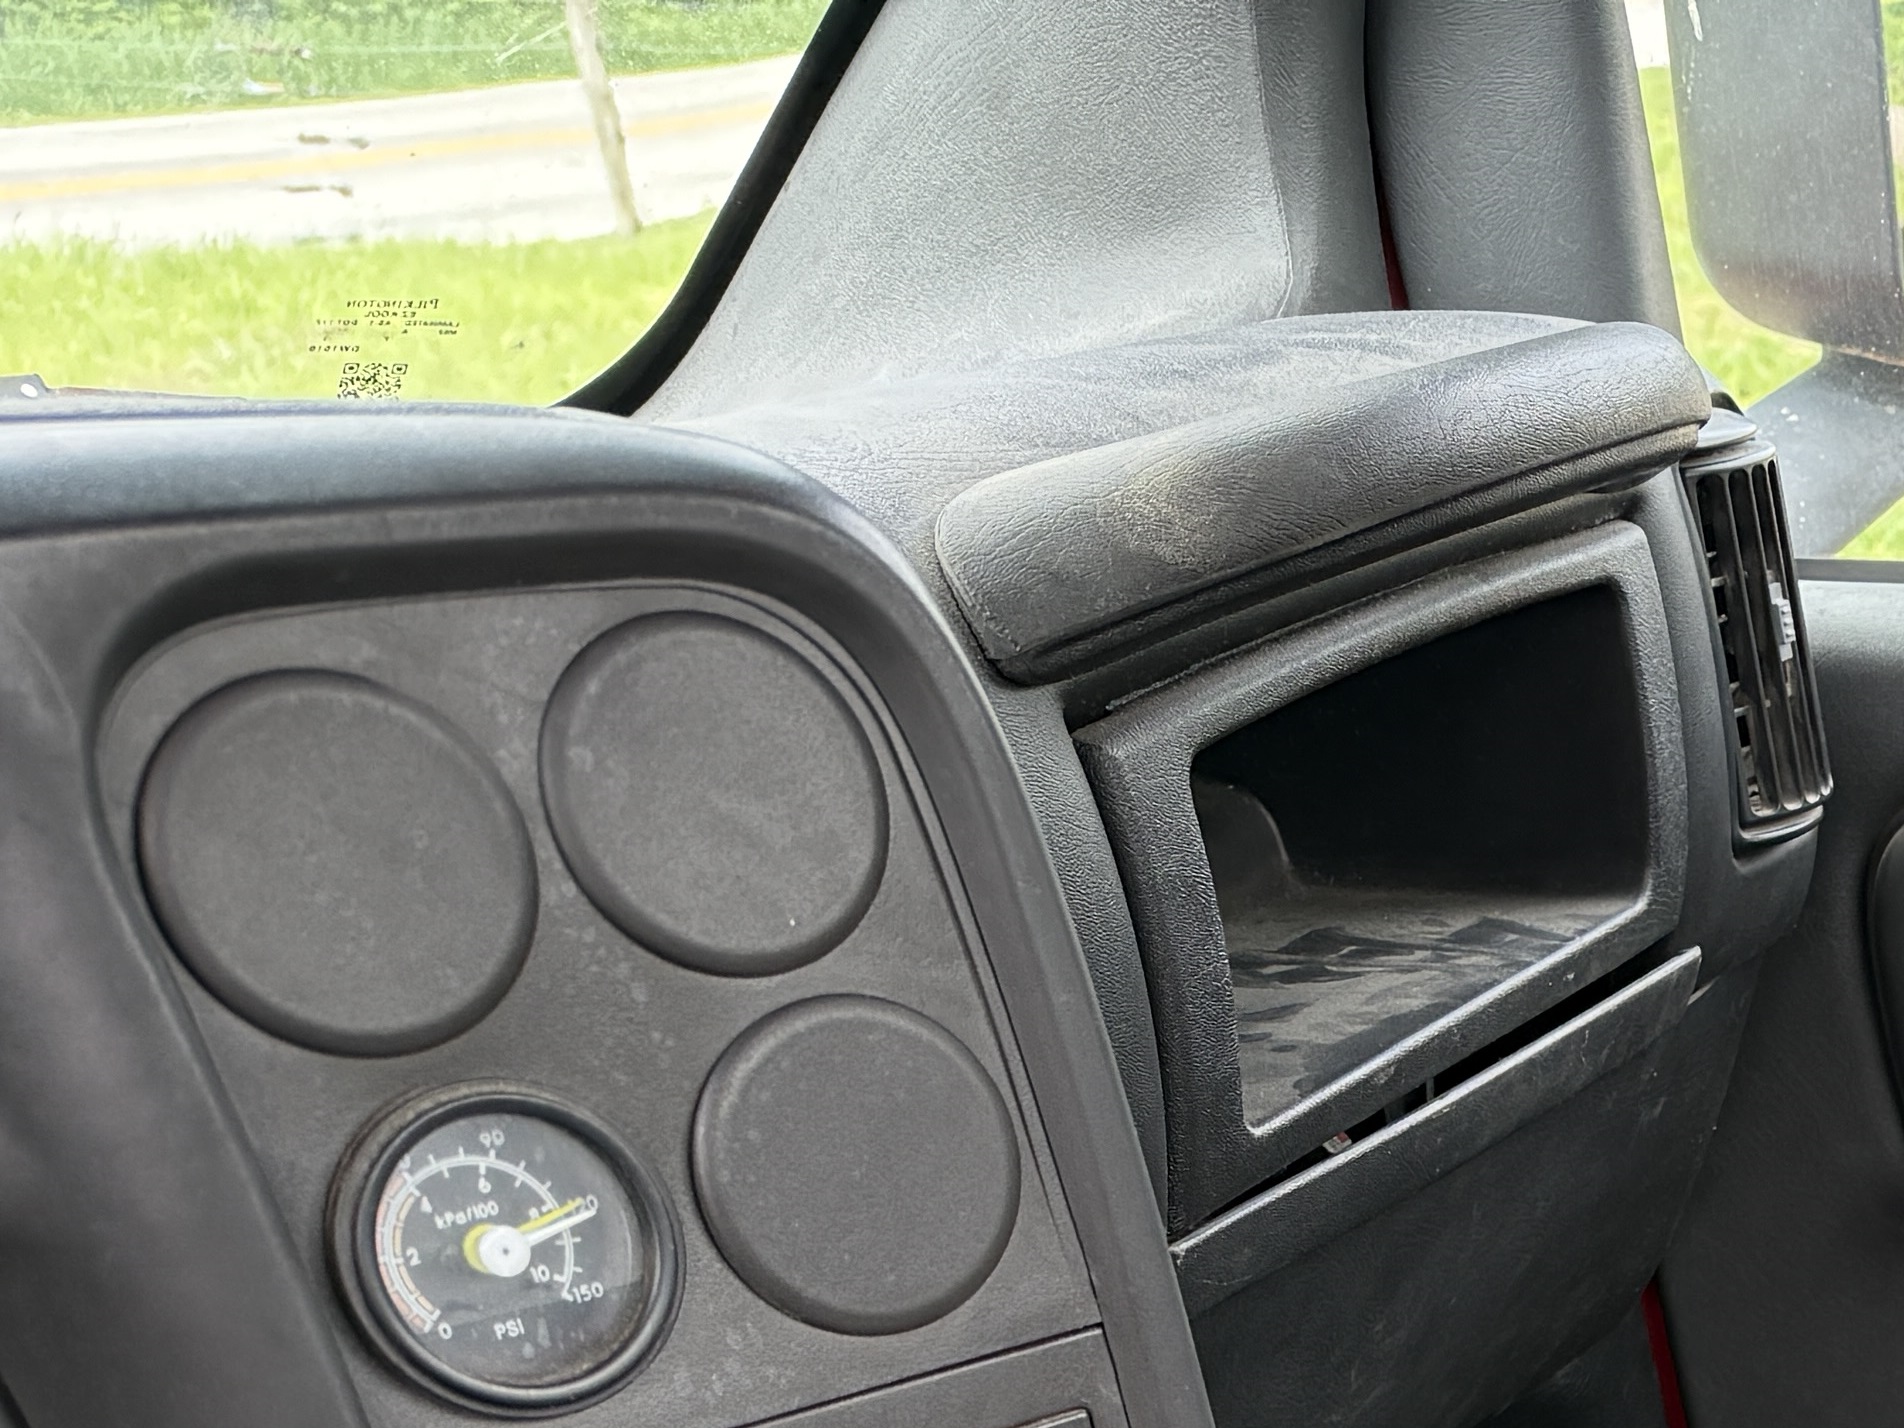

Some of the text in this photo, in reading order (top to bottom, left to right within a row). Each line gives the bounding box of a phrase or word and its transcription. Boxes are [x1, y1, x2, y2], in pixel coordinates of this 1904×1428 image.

[479, 1128, 505, 1148] 90
[478, 1177, 492, 1194] 6
[406, 1246, 421, 1267] 2
[530, 1264, 551, 1284] 10
[573, 1281, 605, 1304] 150
[437, 1322, 453, 1340] 0
[493, 1317, 526, 1340] PSI
